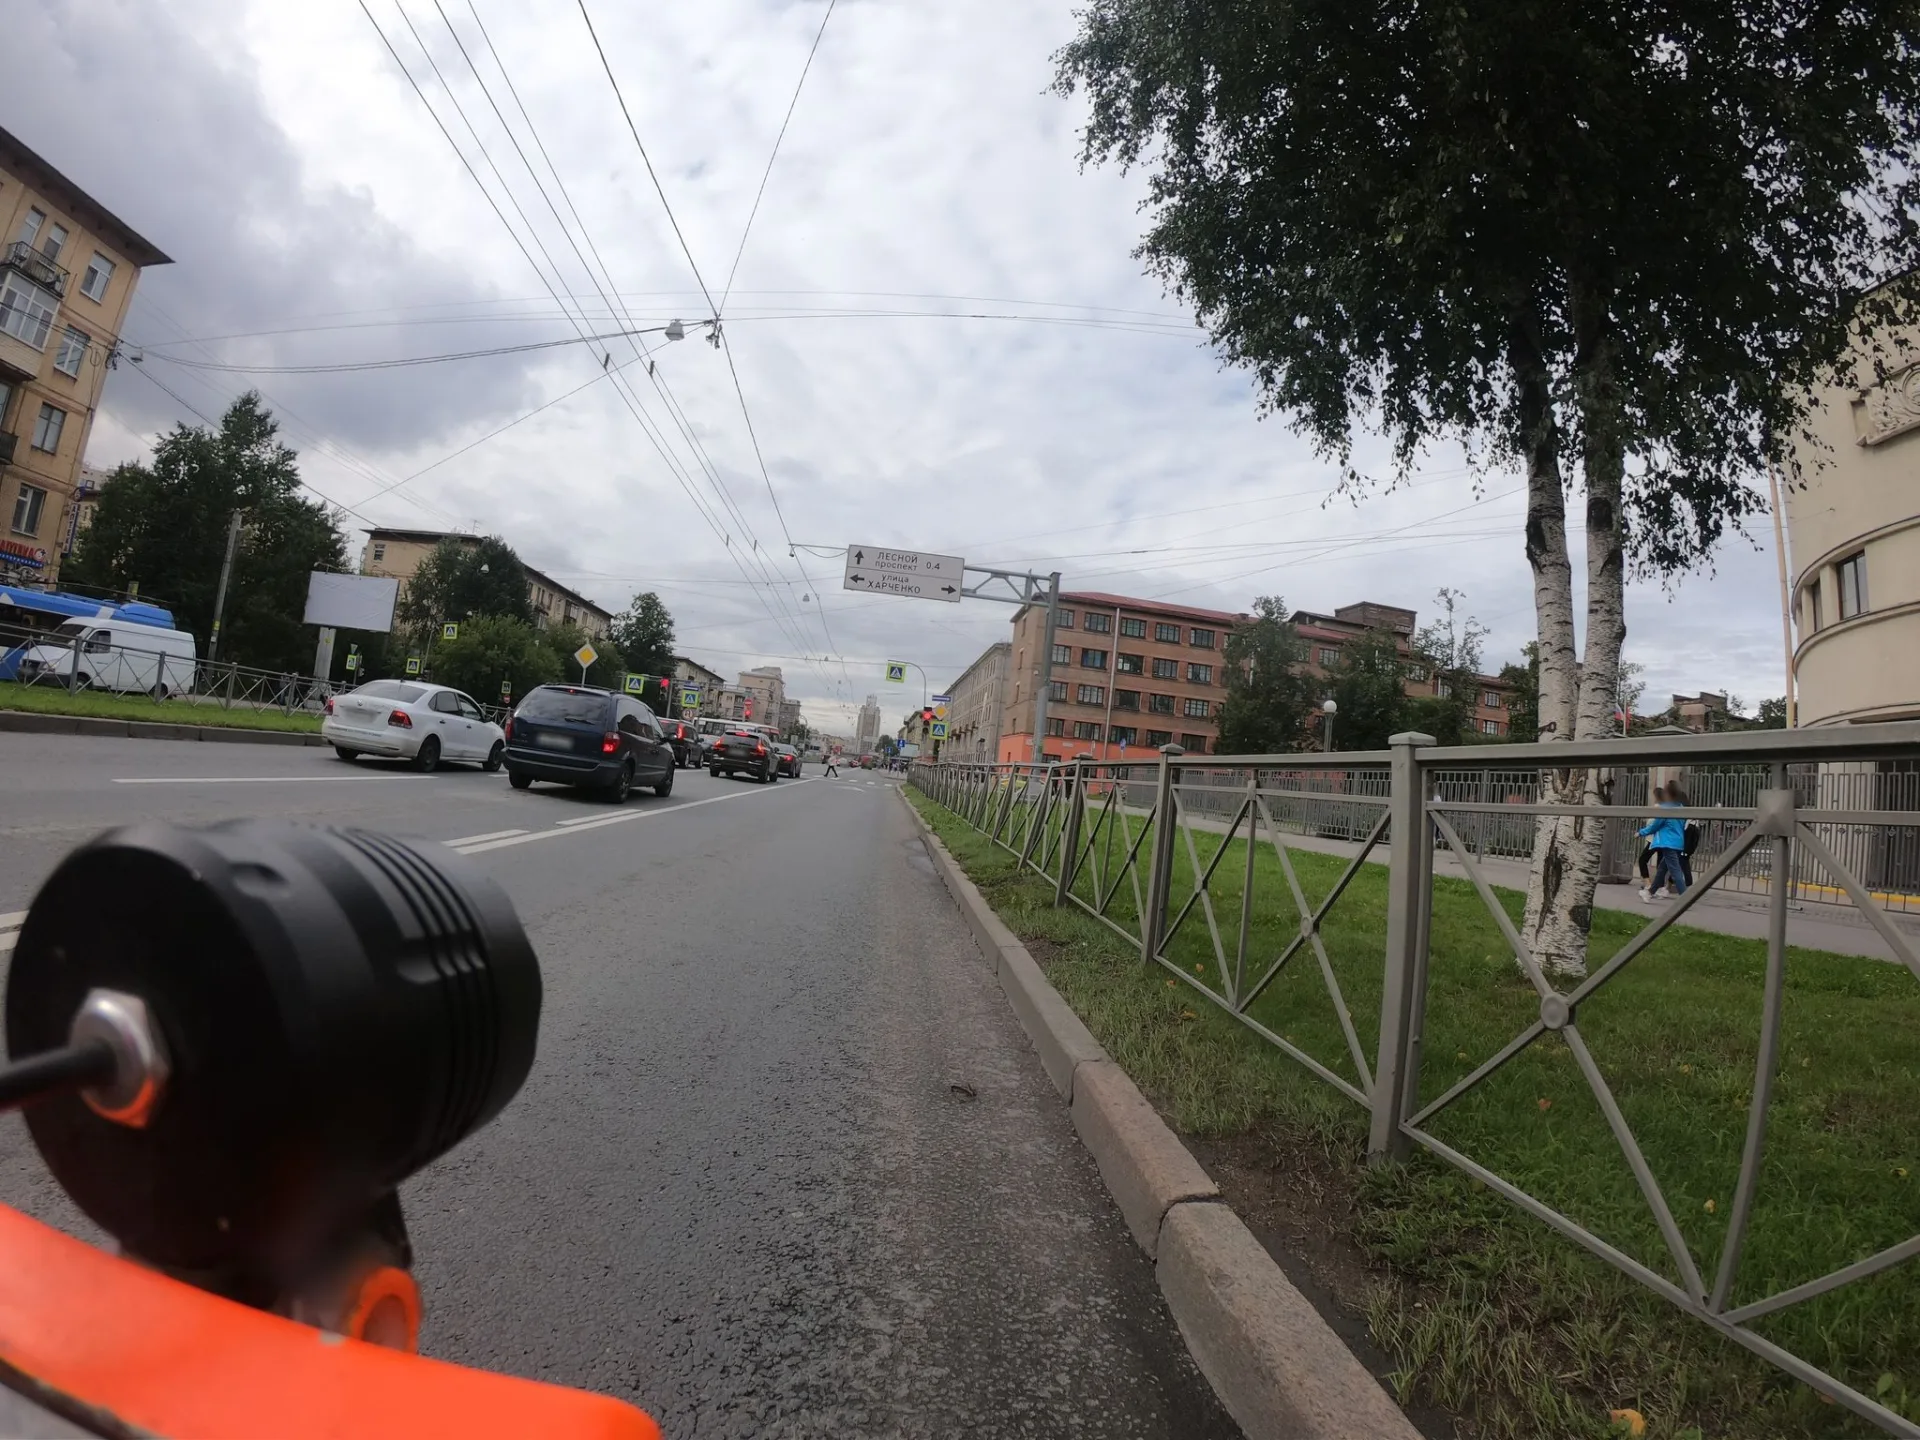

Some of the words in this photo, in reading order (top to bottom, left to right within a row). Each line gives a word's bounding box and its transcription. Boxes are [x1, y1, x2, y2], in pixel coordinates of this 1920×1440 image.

[877, 552, 918, 563] ЛЕСНОЙ
[875, 561, 918, 571] проспект
[926, 562, 940, 570] 0.4
[881, 574, 909, 583] улица
[867, 581, 921, 594] ХАРЧЕНКО
